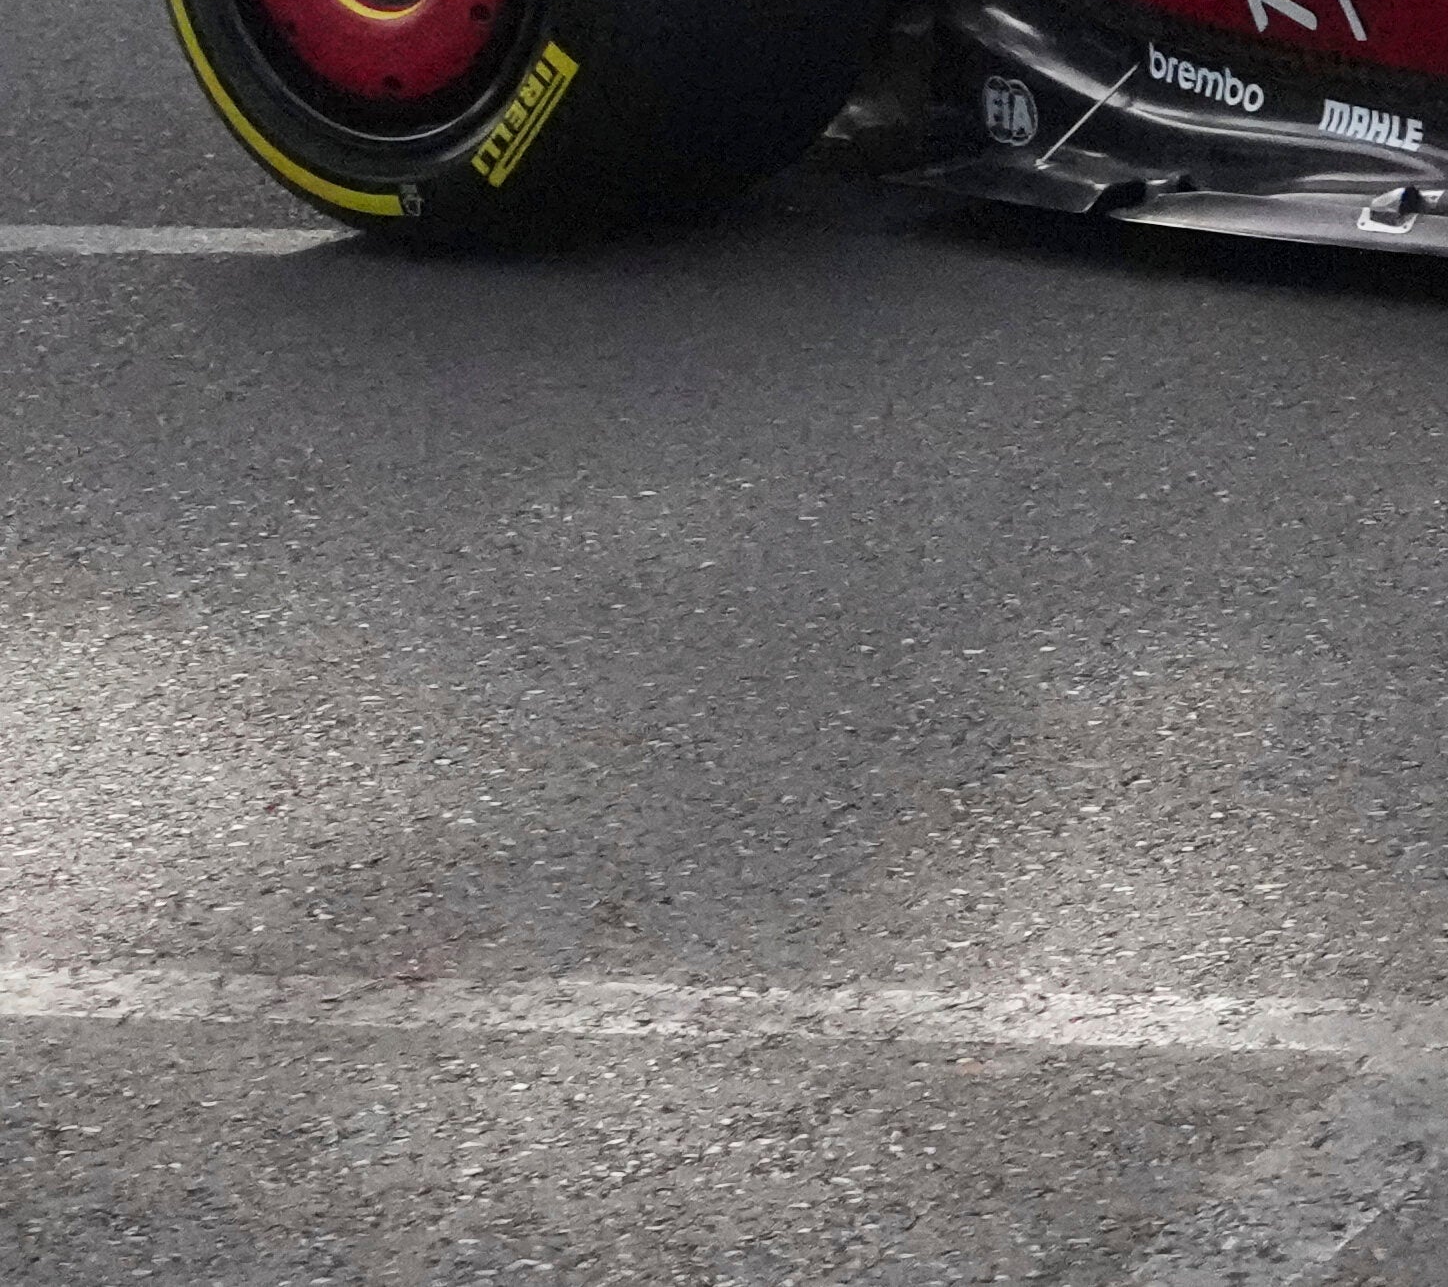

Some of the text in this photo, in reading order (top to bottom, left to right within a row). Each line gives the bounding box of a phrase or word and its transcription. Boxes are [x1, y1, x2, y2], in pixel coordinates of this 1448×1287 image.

[1148, 42, 1265, 113] brembo
[470, 39, 581, 189] PIRELLI
[1317, 98, 1425, 152] MAHLE
